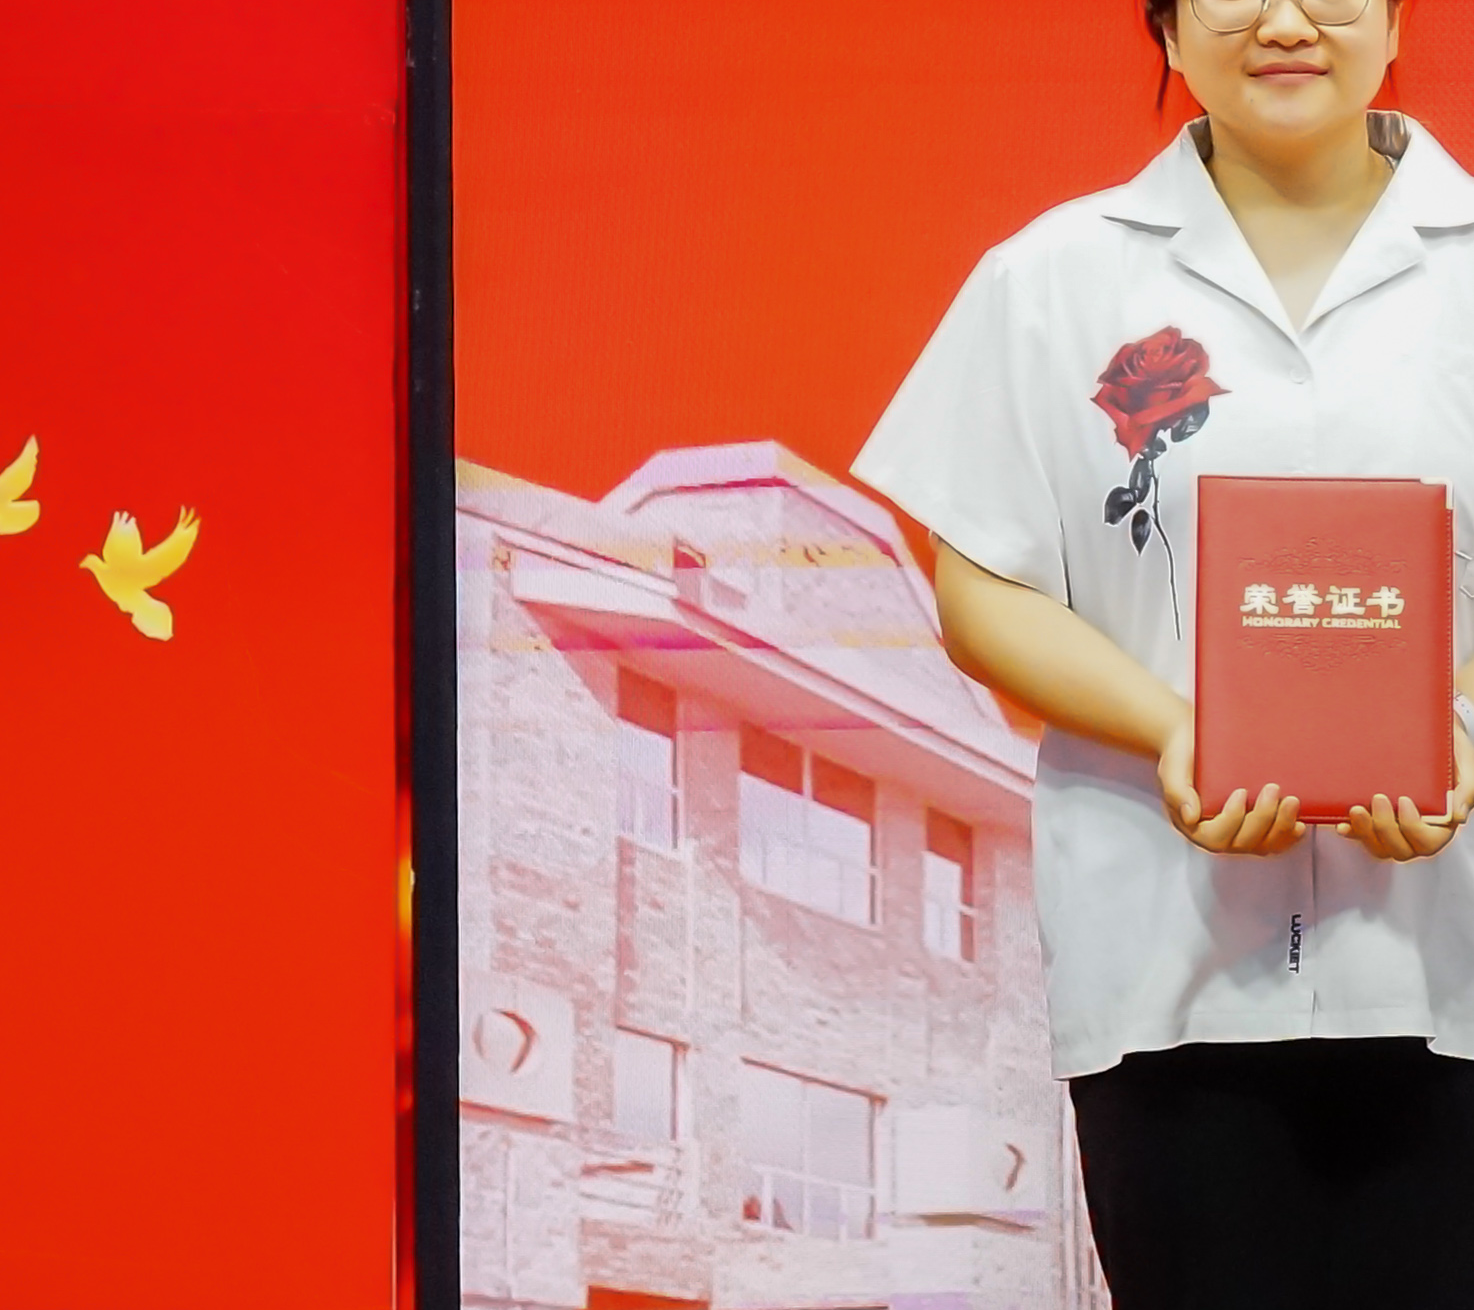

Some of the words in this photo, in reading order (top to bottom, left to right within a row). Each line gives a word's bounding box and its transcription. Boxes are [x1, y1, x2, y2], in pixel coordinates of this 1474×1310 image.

[1239, 584, 1405, 618] 荣誉证书
[1242, 615, 1320, 628] HONORARY
[1321, 616, 1402, 629] CREDENTIAL
